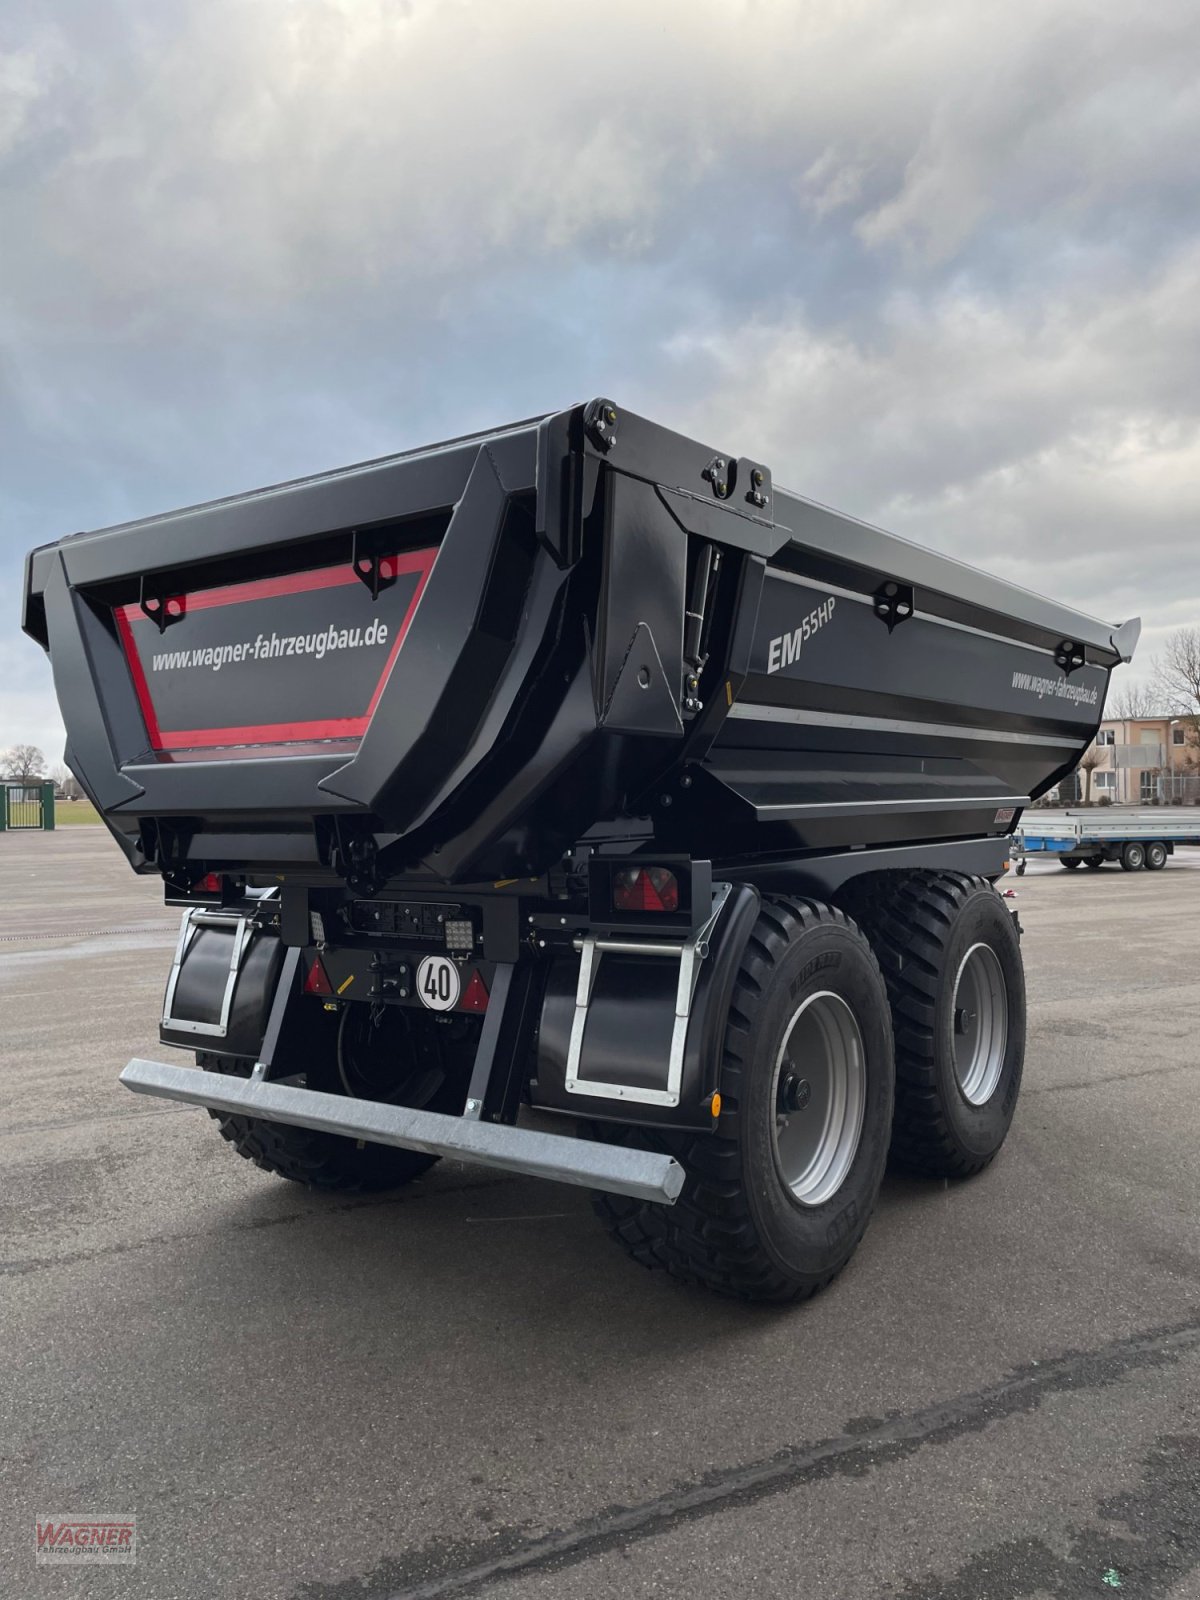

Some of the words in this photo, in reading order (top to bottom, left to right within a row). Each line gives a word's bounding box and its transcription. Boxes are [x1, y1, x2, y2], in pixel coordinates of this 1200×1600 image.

[152, 618, 388, 671] www.wagner-fahrzeugbau.de
[767, 627, 803, 675] EM
[802, 596, 836, 641] 55HP
[1011, 671, 1098, 706] www.wagner-fahrzeugbau.de
[424, 963, 451, 1002] 40
